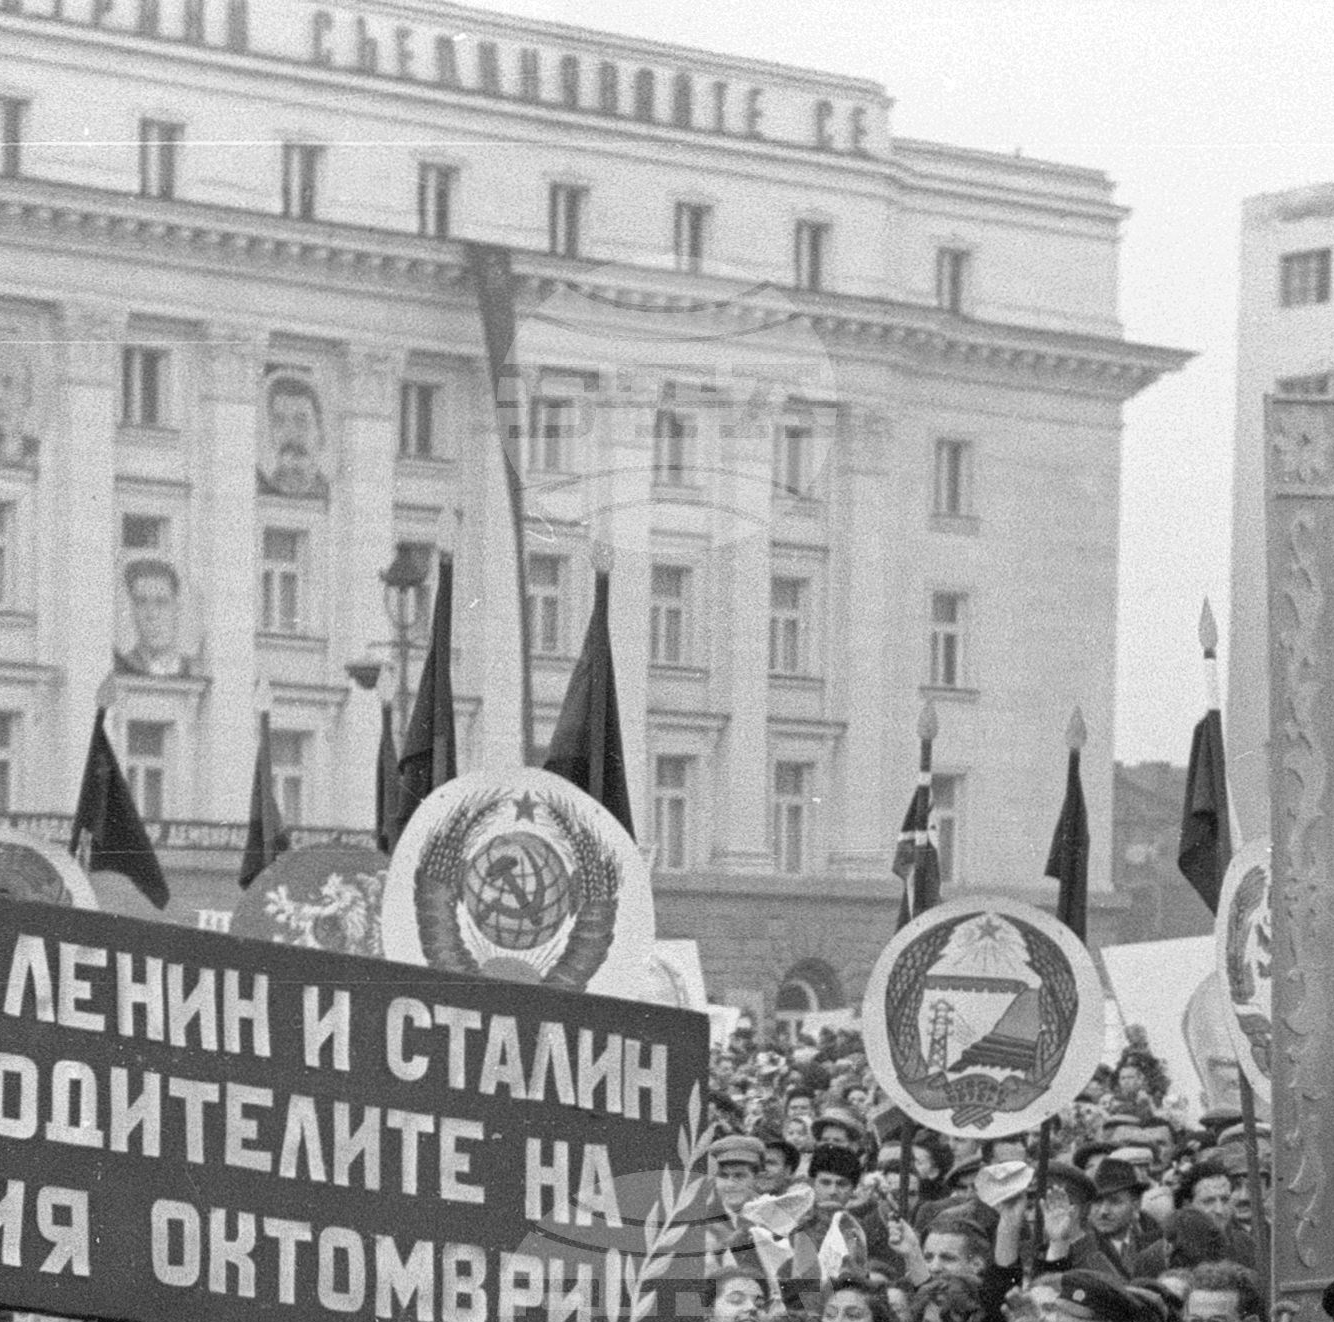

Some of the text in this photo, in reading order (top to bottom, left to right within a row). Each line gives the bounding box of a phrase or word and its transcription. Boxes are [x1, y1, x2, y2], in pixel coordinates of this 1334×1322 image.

[3, 933, 271, 1058] ЛЕНИН
[302, 984, 351, 1072] И
[386, 996, 668, 1124] СТАЛИН
[525, 1136, 623, 1229] НА
